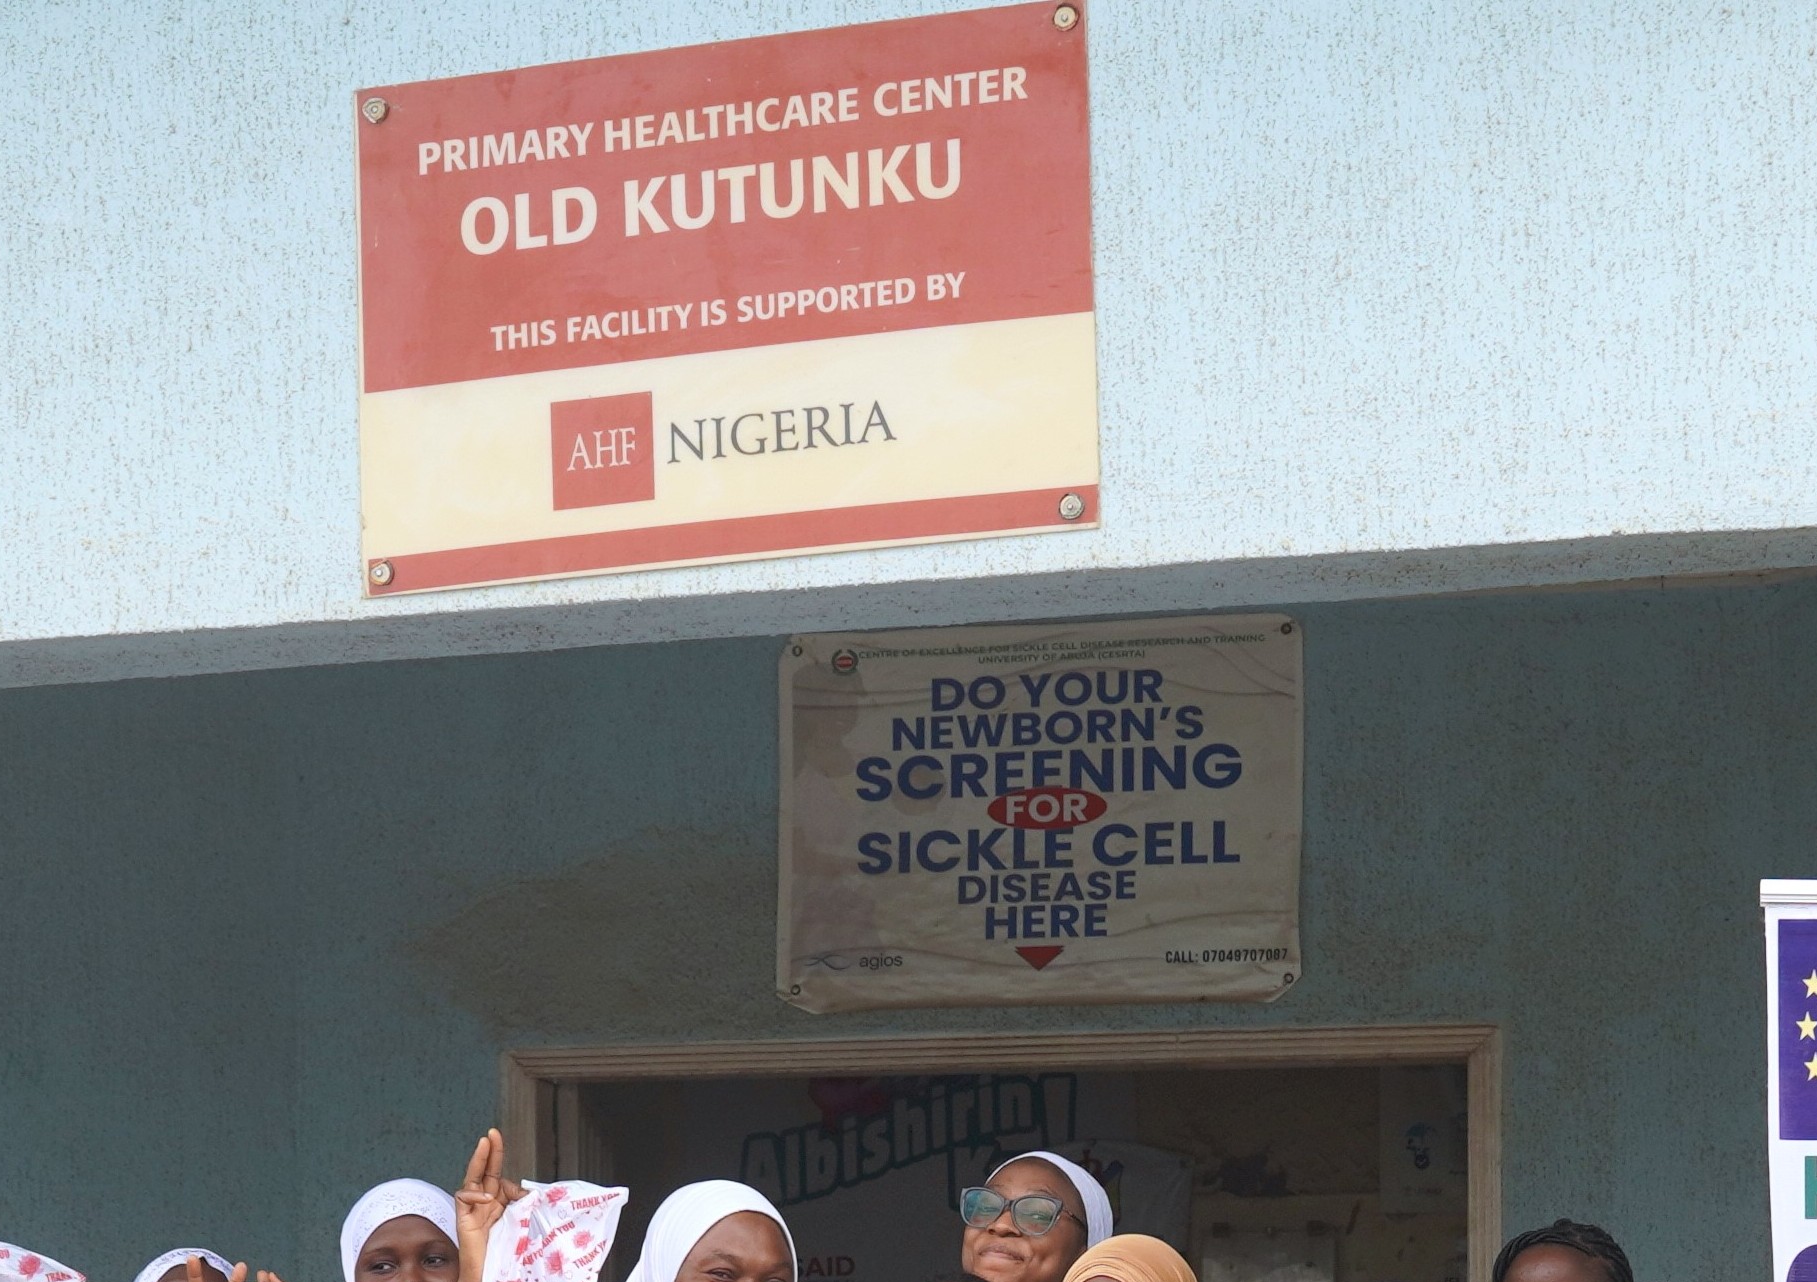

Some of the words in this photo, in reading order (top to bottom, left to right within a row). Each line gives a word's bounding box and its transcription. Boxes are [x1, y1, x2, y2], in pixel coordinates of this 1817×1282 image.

[418, 122, 593, 175] PRIMARY
[605, 88, 859, 152] HEALTHCARE
[873, 67, 1028, 117] CENTER
[461, 186, 596, 255] OLD
[625, 139, 962, 236] KUTUNKU
[490, 320, 557, 351] THIS
[566, 304, 693, 342] FACILITY
[701, 301, 728, 328] IS
[736, 278, 915, 322] SUPPORTED
[926, 272, 965, 301] BY
[567, 428, 636, 471] AHF
[667, 400, 896, 464] NIGERIA
[859, 651, 900, 659] CENTRE
[1013, 644, 1049, 652] SICKLE
[1052, 642, 1077, 650] CELL
[1081, 640, 1124, 649] DISEASE
[1214, 634, 1265, 643] TRAINING
[979, 654, 1039, 664] UNIVERSITY
[932, 677, 1005, 711] DO
[1019, 669, 1164, 708] YOUR
[892, 706, 1204, 751] NEWBORN'S
[856, 744, 1242, 801] SCREENING
[1005, 795, 1086, 823] FOR
[857, 828, 1074, 875] SICKLE
[1093, 821, 1240, 864] CELL
[958, 871, 1136, 904] DISEASE
[985, 904, 1108, 939] HERE
[859, 953, 903, 970] agios
[1166, 951, 1199, 963] CALL:
